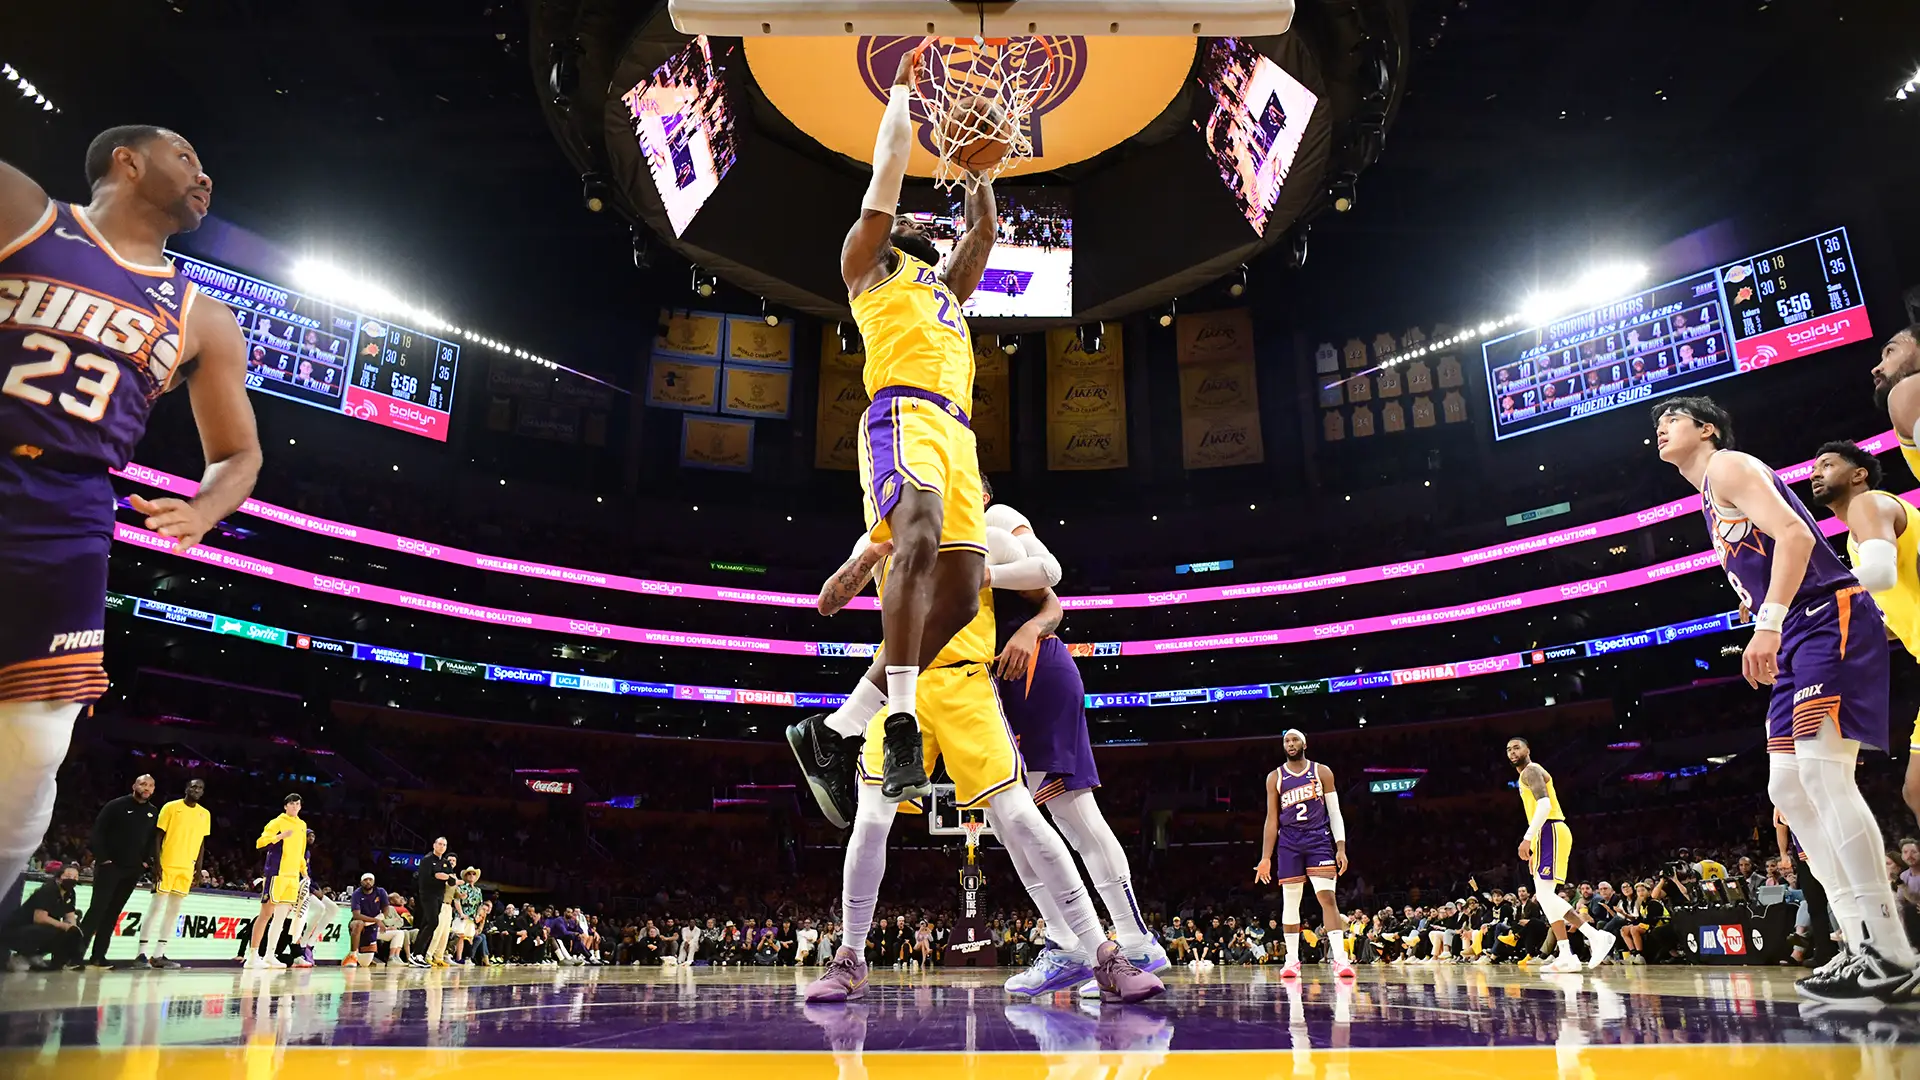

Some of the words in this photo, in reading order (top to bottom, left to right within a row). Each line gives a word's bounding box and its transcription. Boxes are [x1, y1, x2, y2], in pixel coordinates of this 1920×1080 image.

[1823, 236, 1841, 254] 36
[1756, 260, 1771, 276] 18
[1772, 255, 1786, 270] 18
[1829, 257, 1847, 275] 35
[181, 261, 237, 290] SCORING
[238, 279, 288, 306] LEADERS
[1760, 281, 1775, 296] 30
[1778, 276, 1787, 291] 5
[146, 287, 179, 310] PayPal
[1776, 292, 1812, 318] 5:56
[237, 311, 247, 326] 5
[1549, 312, 1595, 340] SCORING
[1596, 297, 1644, 325] LEADERS
[1619, 301, 1683, 328] LAKERS
[1700, 307, 1710, 322] 4
[284, 326, 295, 340] 4
[1652, 322, 1661, 337] 4
[1786, 318, 1850, 344] boldyn
[330, 340, 340, 354] 4
[390, 331, 400, 345] 18
[402, 334, 412, 349] 18
[1606, 336, 1615, 352] 5
[1706, 337, 1716, 353] 3
[278, 354, 289, 370] 5
[385, 349, 397, 364] 30
[400, 353, 407, 366] 5
[441, 347, 453, 362] 36
[1658, 352, 1667, 368] 5
[2, 332, 121, 423] 23
[325, 368, 335, 383] 3
[439, 366, 450, 381] 35
[1518, 363, 1531, 378] 10
[1612, 365, 1620, 381] 6
[391, 371, 418, 394] 5:56
[1568, 378, 1576, 394] 7
[1065, 386, 1109, 400] LAKERS
[1523, 390, 1535, 406] 12
[1570, 394, 1615, 417] PHOENIX
[389, 403, 436, 425] boldyn
[123, 465, 170, 486] oldyn
[1636, 502, 1683, 523] boldyn
[261, 507, 306, 526] COVERAGE
[307, 519, 357, 537] SOLUTIONS
[119, 528, 170, 549] WIRELESS
[172, 540, 222, 563] CVERAGE
[223, 555, 274, 576] SOLUTIONS
[397, 537, 440, 556] boldyn
[1462, 547, 1503, 564] WIRELESS
[1504, 537, 1547, 558] COVERAGE
[1548, 527, 1597, 545] SOLUTIONS
[476, 558, 518, 571] WIRELESS
[519, 564, 561, 578] COVERAGE
[562, 570, 606, 584] SOLUTIONS
[1382, 561, 1424, 577] boldyn
[1646, 560, 1692, 579] WIRELESS
[313, 576, 361, 595] boldyn
[641, 581, 682, 595] boldyn
[1222, 586, 1261, 597] WIRELESS
[1262, 582, 1302, 593] COVERAGE
[1304, 576, 1346, 588] SOLUTIONS
[1560, 580, 1608, 597] boldyn
[717, 590, 756, 601] WIRELESS
[757, 593, 796, 604] COVERAGE
[1071, 598, 1114, 607] SOLUTIONS
[1147, 591, 1187, 604] boldyn
[145, 601, 166, 612] JOSH
[174, 607, 208, 620] JACKSON
[165, 612, 187, 623] RUSH
[400, 595, 442, 611] WIRELESS
[443, 604, 485, 619] COVERAGE
[486, 611, 532, 624] SOLUTIONS
[1390, 613, 1432, 627] WIRELESS
[1433, 606, 1475, 620] COVERAGE
[1476, 598, 1522, 613] SOLUTIONS
[247, 625, 280, 641] Sprite
[569, 620, 610, 636] boldyn
[1313, 623, 1355, 637] boldyn
[1677, 620, 1721, 635] crypto.com
[312, 640, 344, 652] TOYOTA
[646, 633, 685, 644] WIRELESS
[686, 636, 726, 647] COVERAGE
[727, 640, 769, 650] SOLUTIONS
[1154, 641, 1193, 651] WIRELESS
[1194, 637, 1234, 648] COVERAGE
[1235, 634, 1278, 644] SOLUTIONS
[1594, 634, 1648, 653] Spectrum
[371, 647, 409, 659] AMERICAN
[375, 655, 409, 666] EXPRESS
[1545, 648, 1576, 659] TOYOTA
[1468, 658, 1509, 672] boldyn
[493, 667, 542, 682] Spectrum
[558, 677, 578, 686] UCLA
[1363, 676, 1389, 684] ULTRA
[1394, 666, 1454, 682] TOSHIBA
[631, 685, 668, 695] crypto.com
[737, 691, 792, 704] TOSHIBA
[1225, 688, 1262, 697] crypto.com
[1107, 696, 1145, 705] DELTA
[533, 780, 563, 793] Coca-Cola
[1281, 785, 1313, 808] SUNS
[1296, 803, 1308, 821] 2
[966, 892, 976, 900] GET
[966, 901, 976, 909] THE
[966, 909, 976, 918] APP
[321, 923, 341, 942] 24
[1703, 930, 1717, 949] NBA
